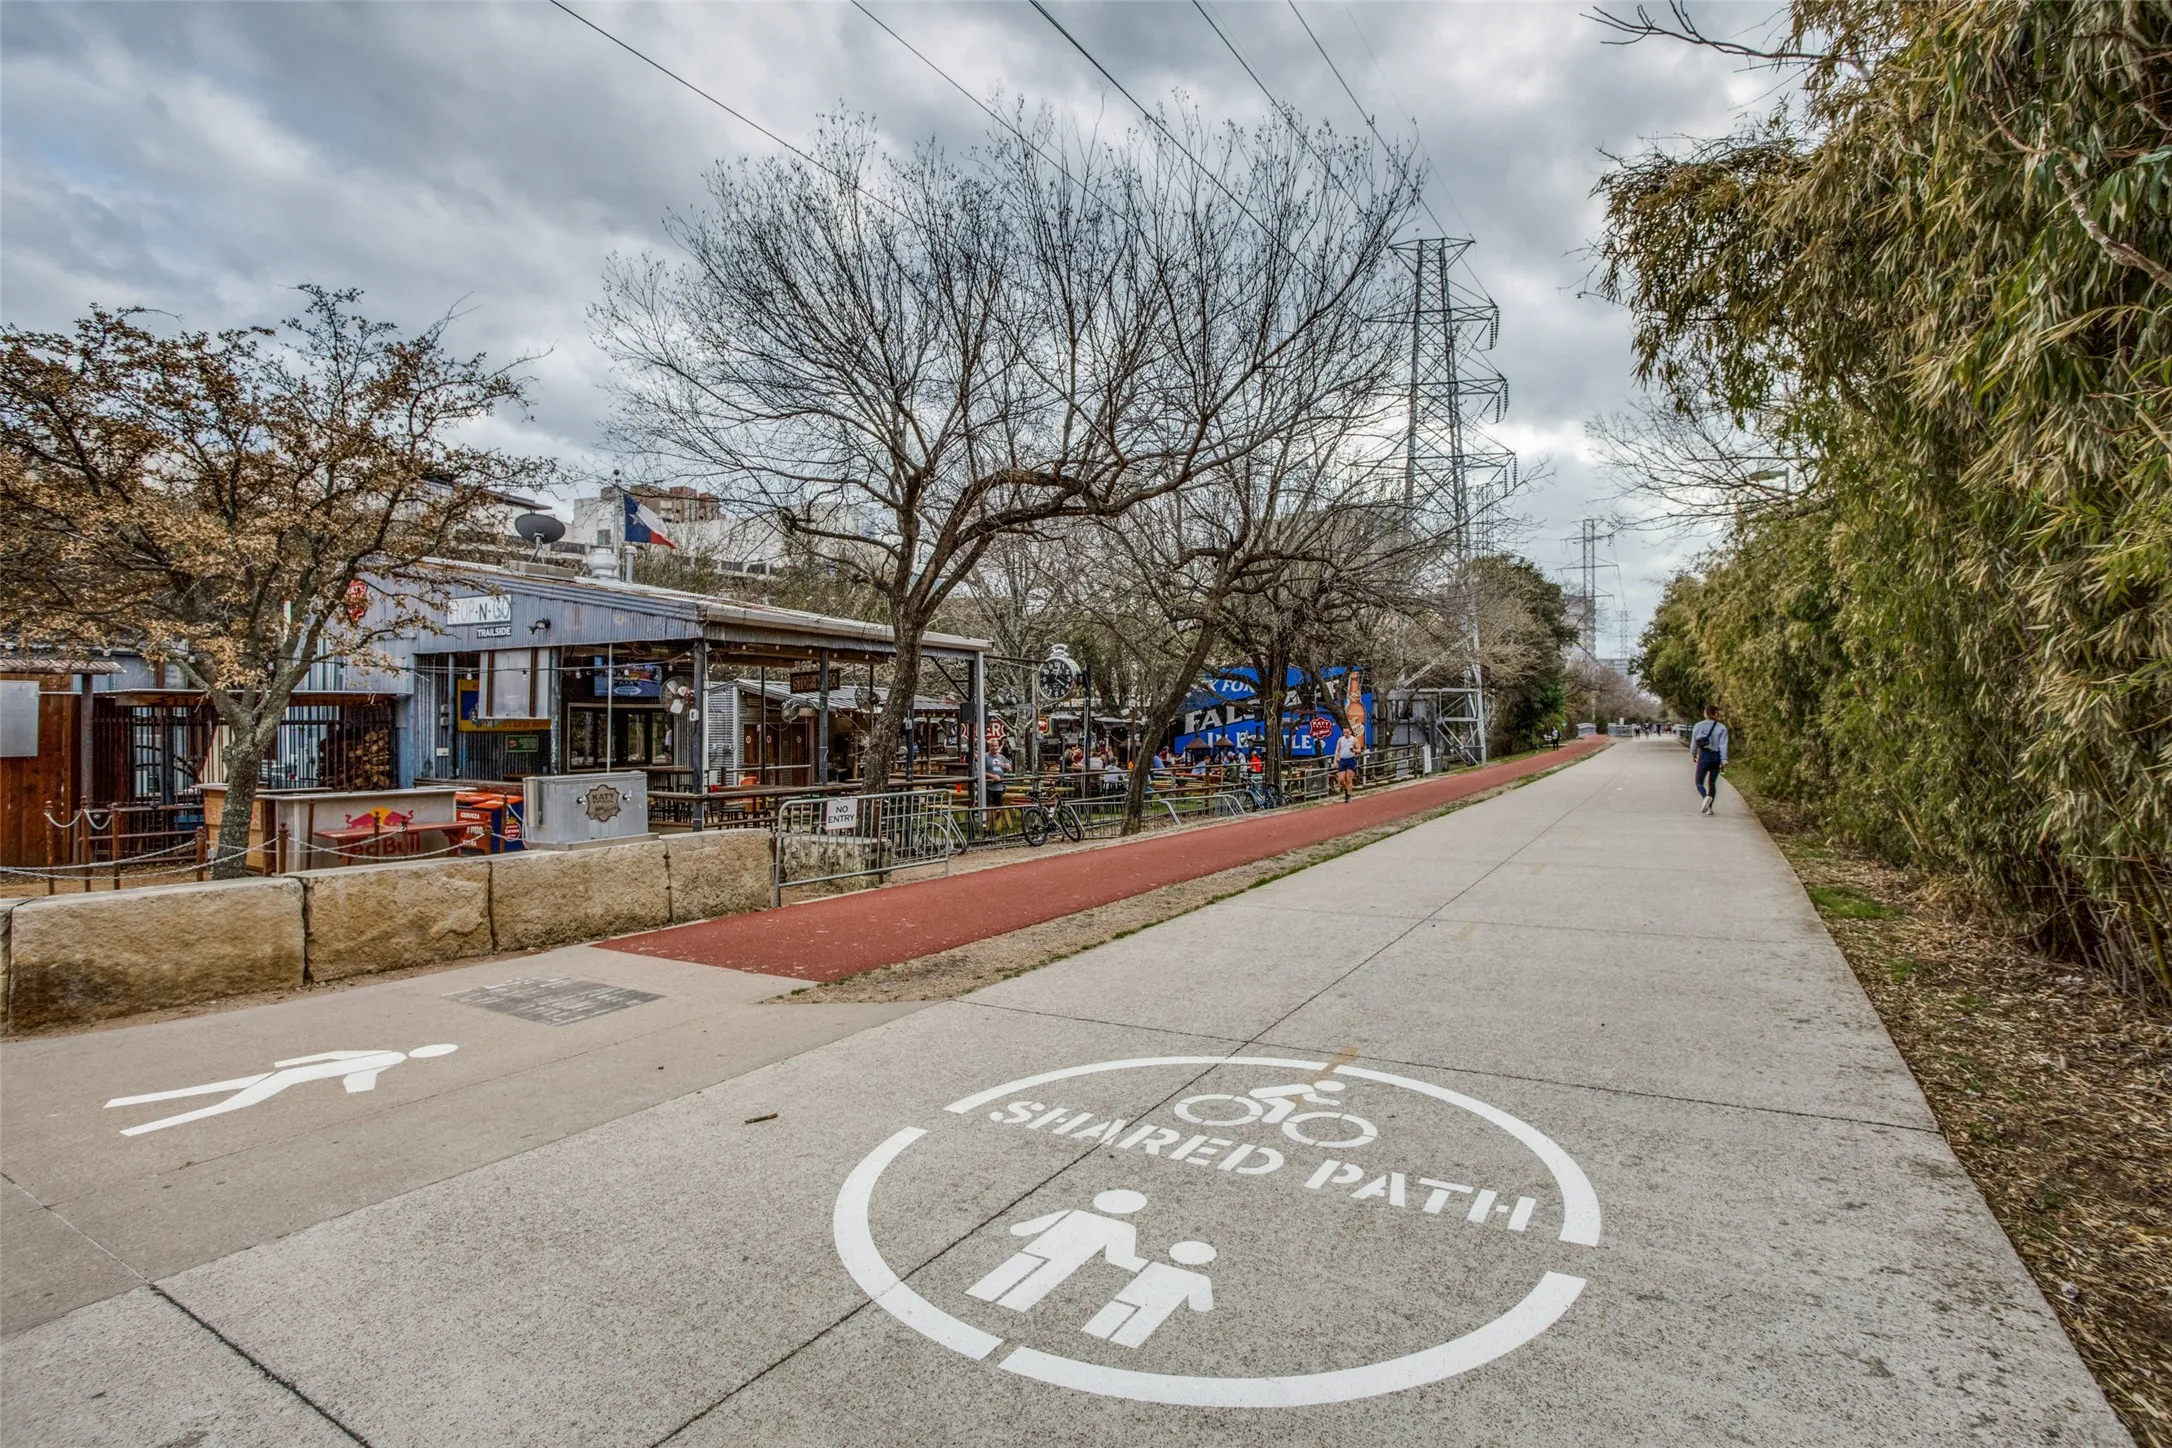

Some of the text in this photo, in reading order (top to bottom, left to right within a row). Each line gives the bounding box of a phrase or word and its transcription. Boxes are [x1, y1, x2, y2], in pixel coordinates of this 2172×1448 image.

[477, 627, 511, 637] TRAILSIDE
[836, 805, 848, 813] NO
[828, 814, 855, 824] ENTRY
[990, 1101, 1536, 1232] SHARED PATH
